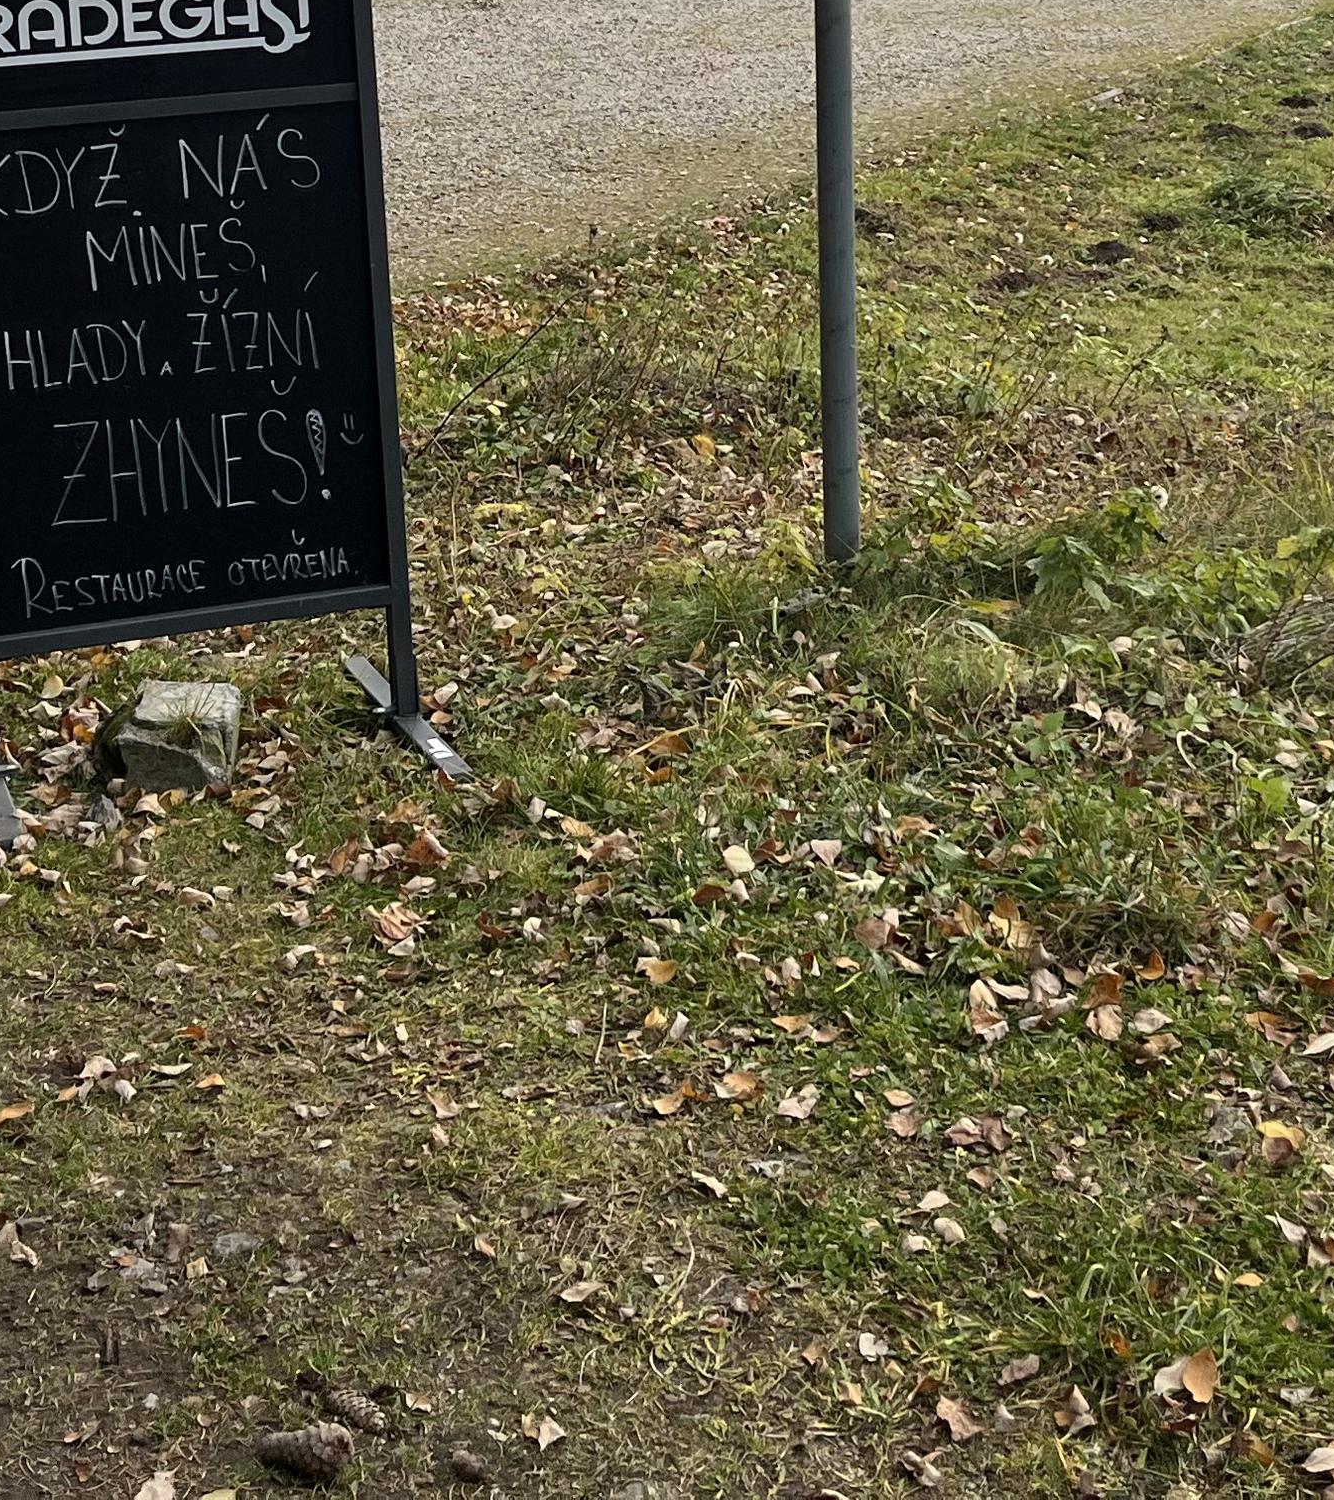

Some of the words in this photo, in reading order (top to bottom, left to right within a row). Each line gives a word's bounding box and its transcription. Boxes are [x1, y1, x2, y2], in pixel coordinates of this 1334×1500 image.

[178, 113, 322, 199] NÁS
[3, 319, 147, 390] HLADY
[186, 270, 320, 373] ŽÍZNÍ
[51, 375, 333, 526] ZHYNEŠ!
